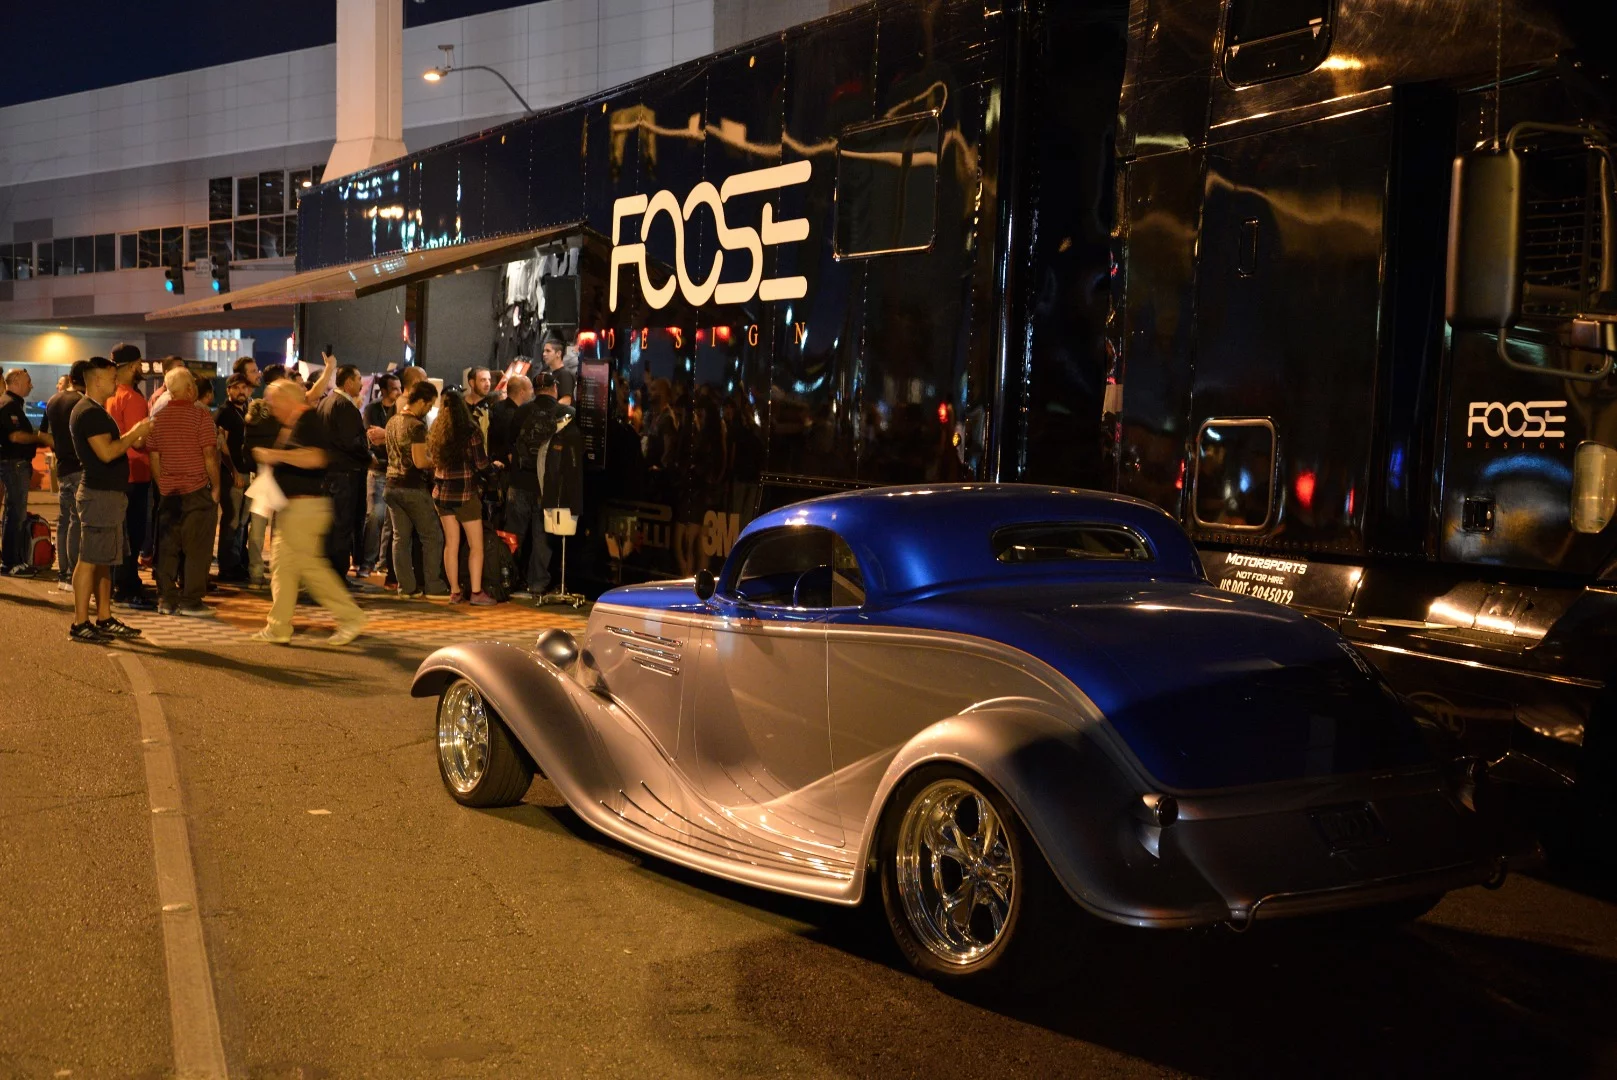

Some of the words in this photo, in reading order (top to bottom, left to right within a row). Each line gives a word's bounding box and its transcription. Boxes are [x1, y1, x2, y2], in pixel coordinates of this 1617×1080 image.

[609, 159, 812, 313] FOOSE
[607, 322, 806, 350] DESIGN
[1467, 400, 1567, 437] FOOSE
[1466, 441, 1565, 449] DESIGN
[703, 510, 740, 557] 3M
[1225, 552, 1308, 575] MOTORSPORTS
[1235, 570, 1252, 580] NOT
[1252, 573, 1268, 582] FOR
[1268, 575, 1285, 585] HIRE
[1251, 585, 1294, 605] 2045079
